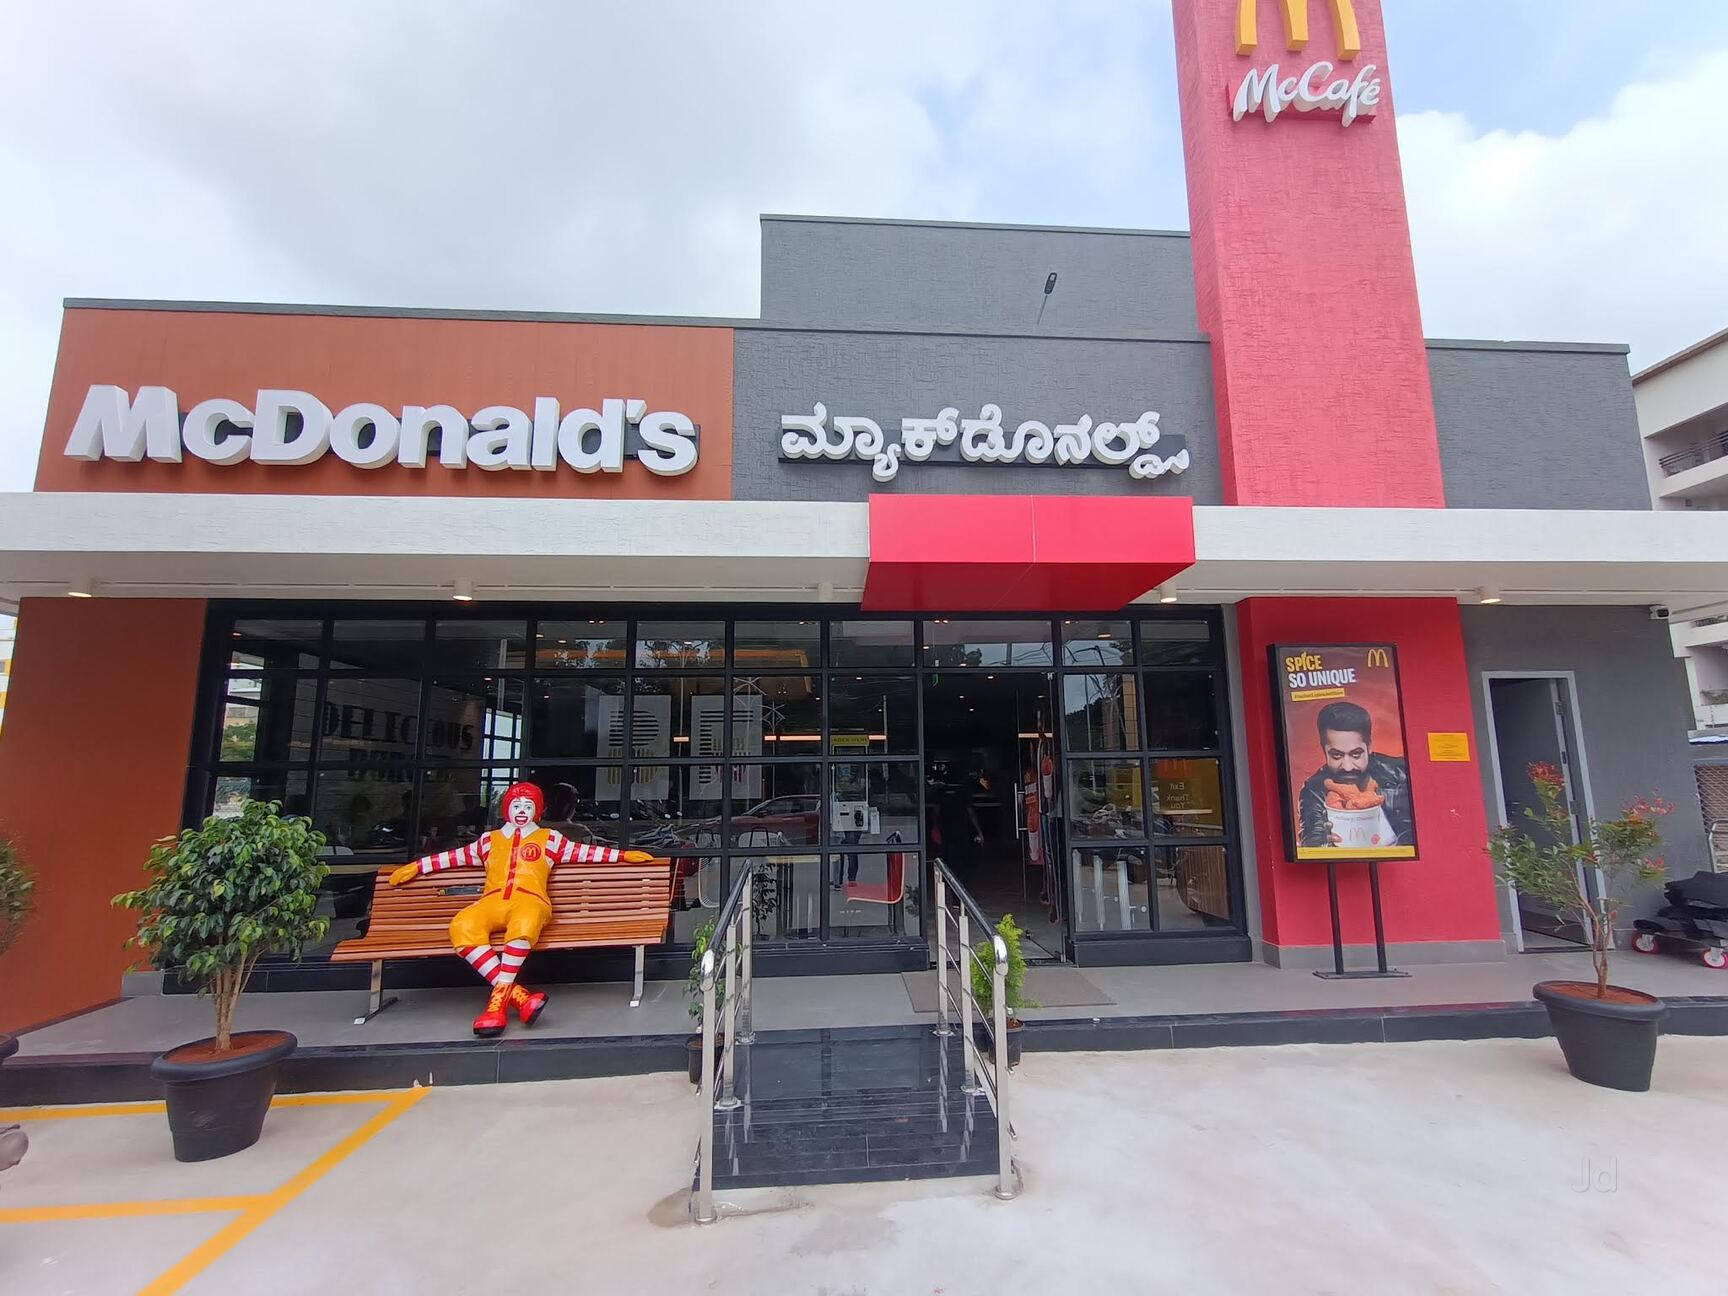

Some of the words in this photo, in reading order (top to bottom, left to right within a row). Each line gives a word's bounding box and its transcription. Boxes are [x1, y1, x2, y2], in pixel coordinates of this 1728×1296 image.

[1233, 61, 1381, 127] McCafé
[63, 384, 699, 477] McDonald's
[1285, 651, 1323, 672] SPICE
[1288, 672, 1307, 689] SO
[1308, 668, 1357, 687] UNIQUE
